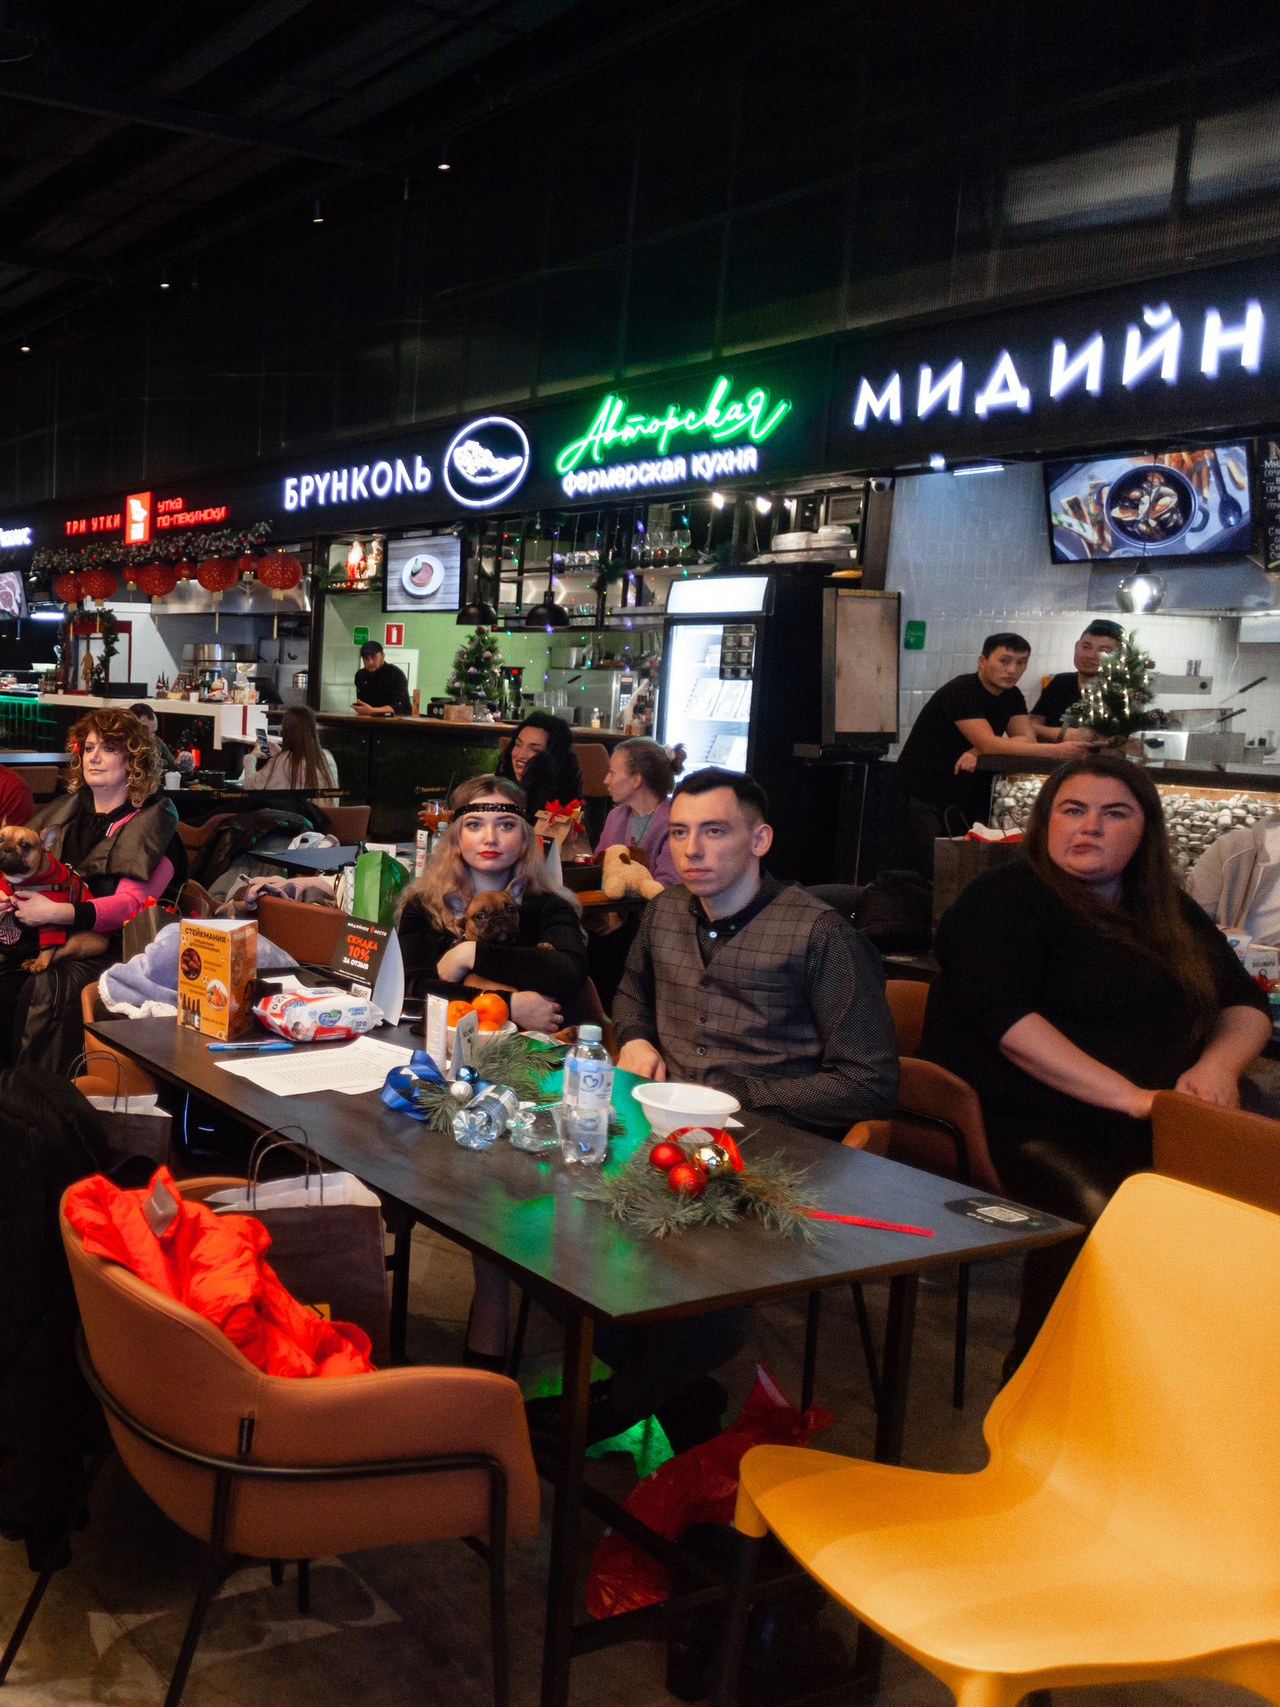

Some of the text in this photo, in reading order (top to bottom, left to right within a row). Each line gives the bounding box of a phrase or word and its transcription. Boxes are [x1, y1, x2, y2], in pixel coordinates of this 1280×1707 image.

[557, 376, 791, 474] Авторская
[284, 455, 432, 512] БРУНКОЛЬ
[65, 519, 87, 536] ТРИ
[90, 513, 121, 533] УТКИ
[184, 928, 227, 944] СТЕЙКМАНИЯ
[346, 934, 378, 951] СКИДКА
[348, 945, 370, 962] 10%
